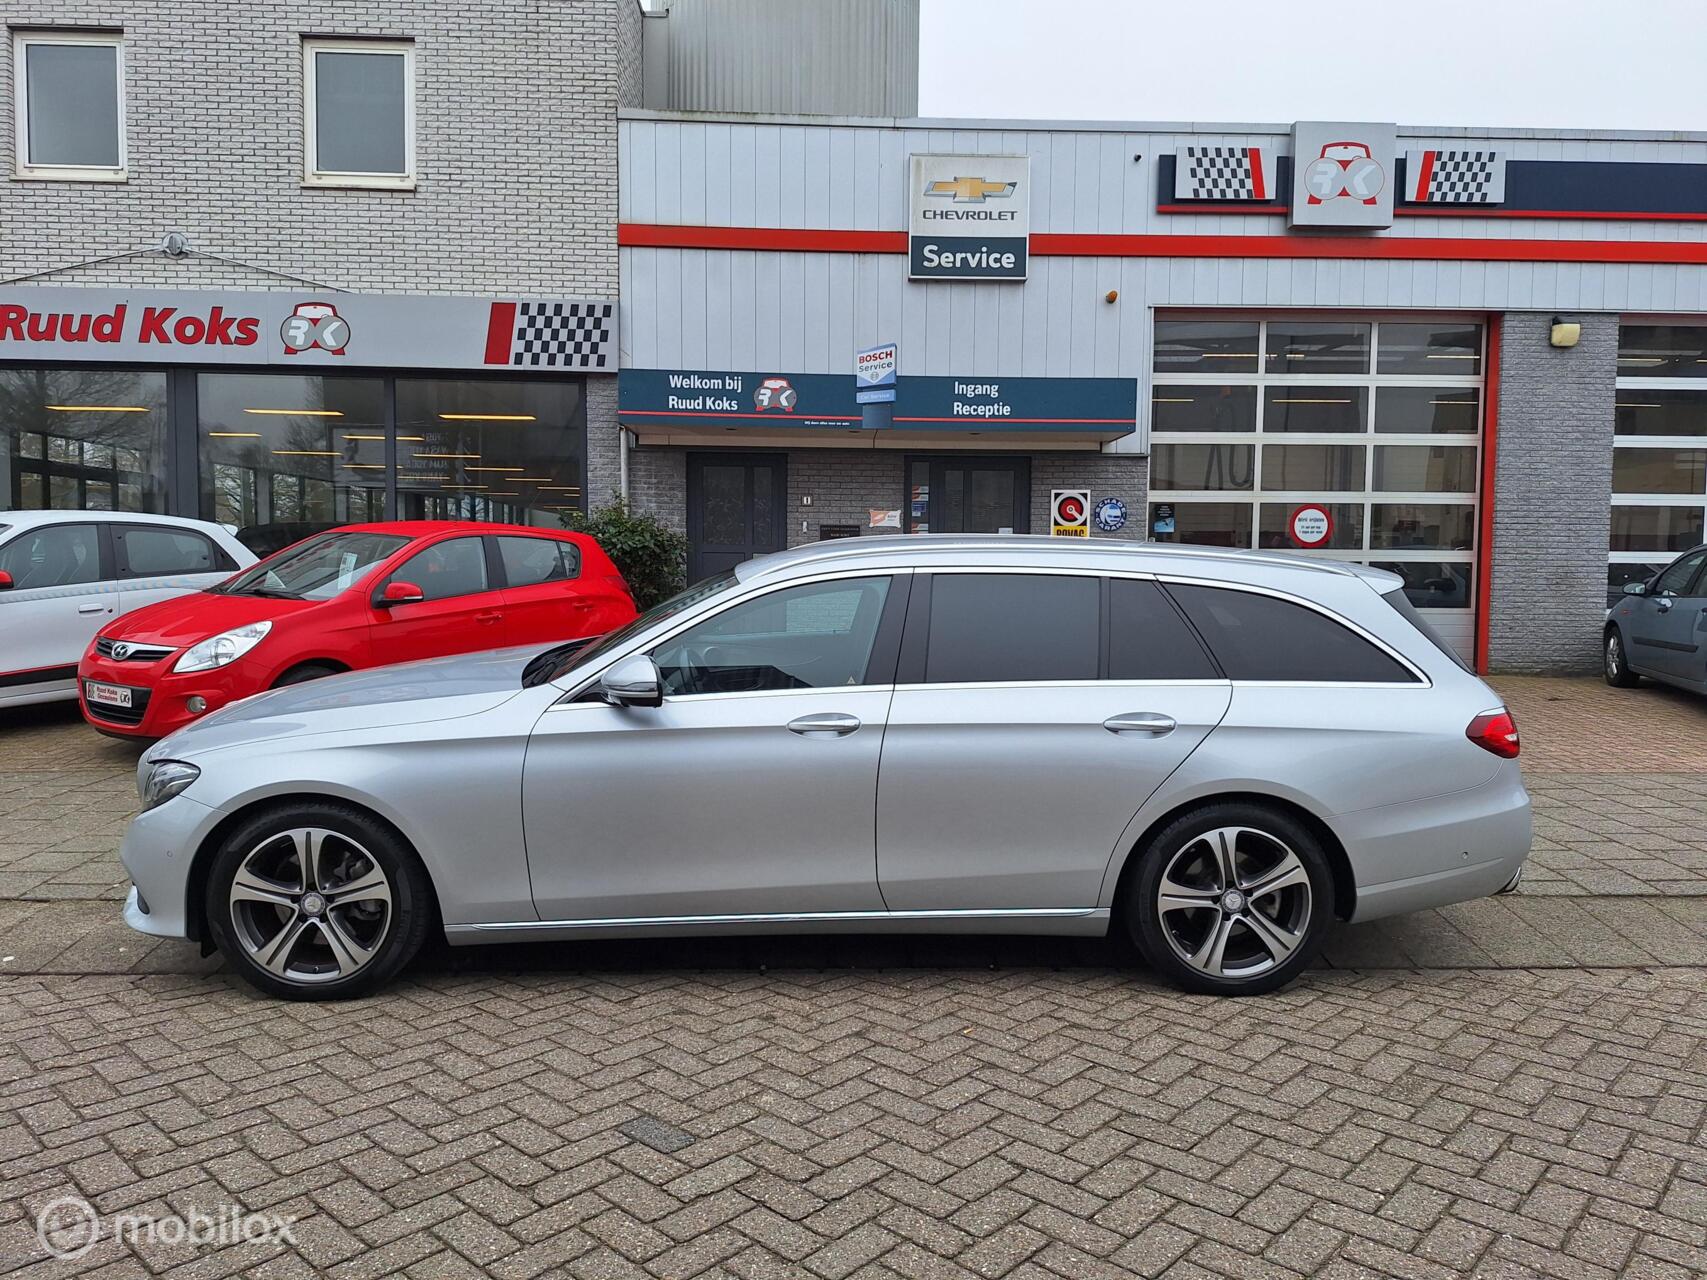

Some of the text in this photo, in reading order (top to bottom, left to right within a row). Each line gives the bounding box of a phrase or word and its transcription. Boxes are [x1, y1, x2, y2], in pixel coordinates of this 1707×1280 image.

[922, 209, 1018, 221] CHEVROLET
[923, 244, 1016, 268] Service
[0, 304, 260, 346] Ruud Koks
[858, 350, 893, 364] BOSCH
[858, 361, 893, 373] Service
[669, 374, 742, 393] Welkom bij
[954, 381, 999, 398] Ingang
[668, 395, 738, 411] Ruud Koks
[953, 401, 1011, 418] Receptie
[1095, 498, 1126, 512] SCHADE
